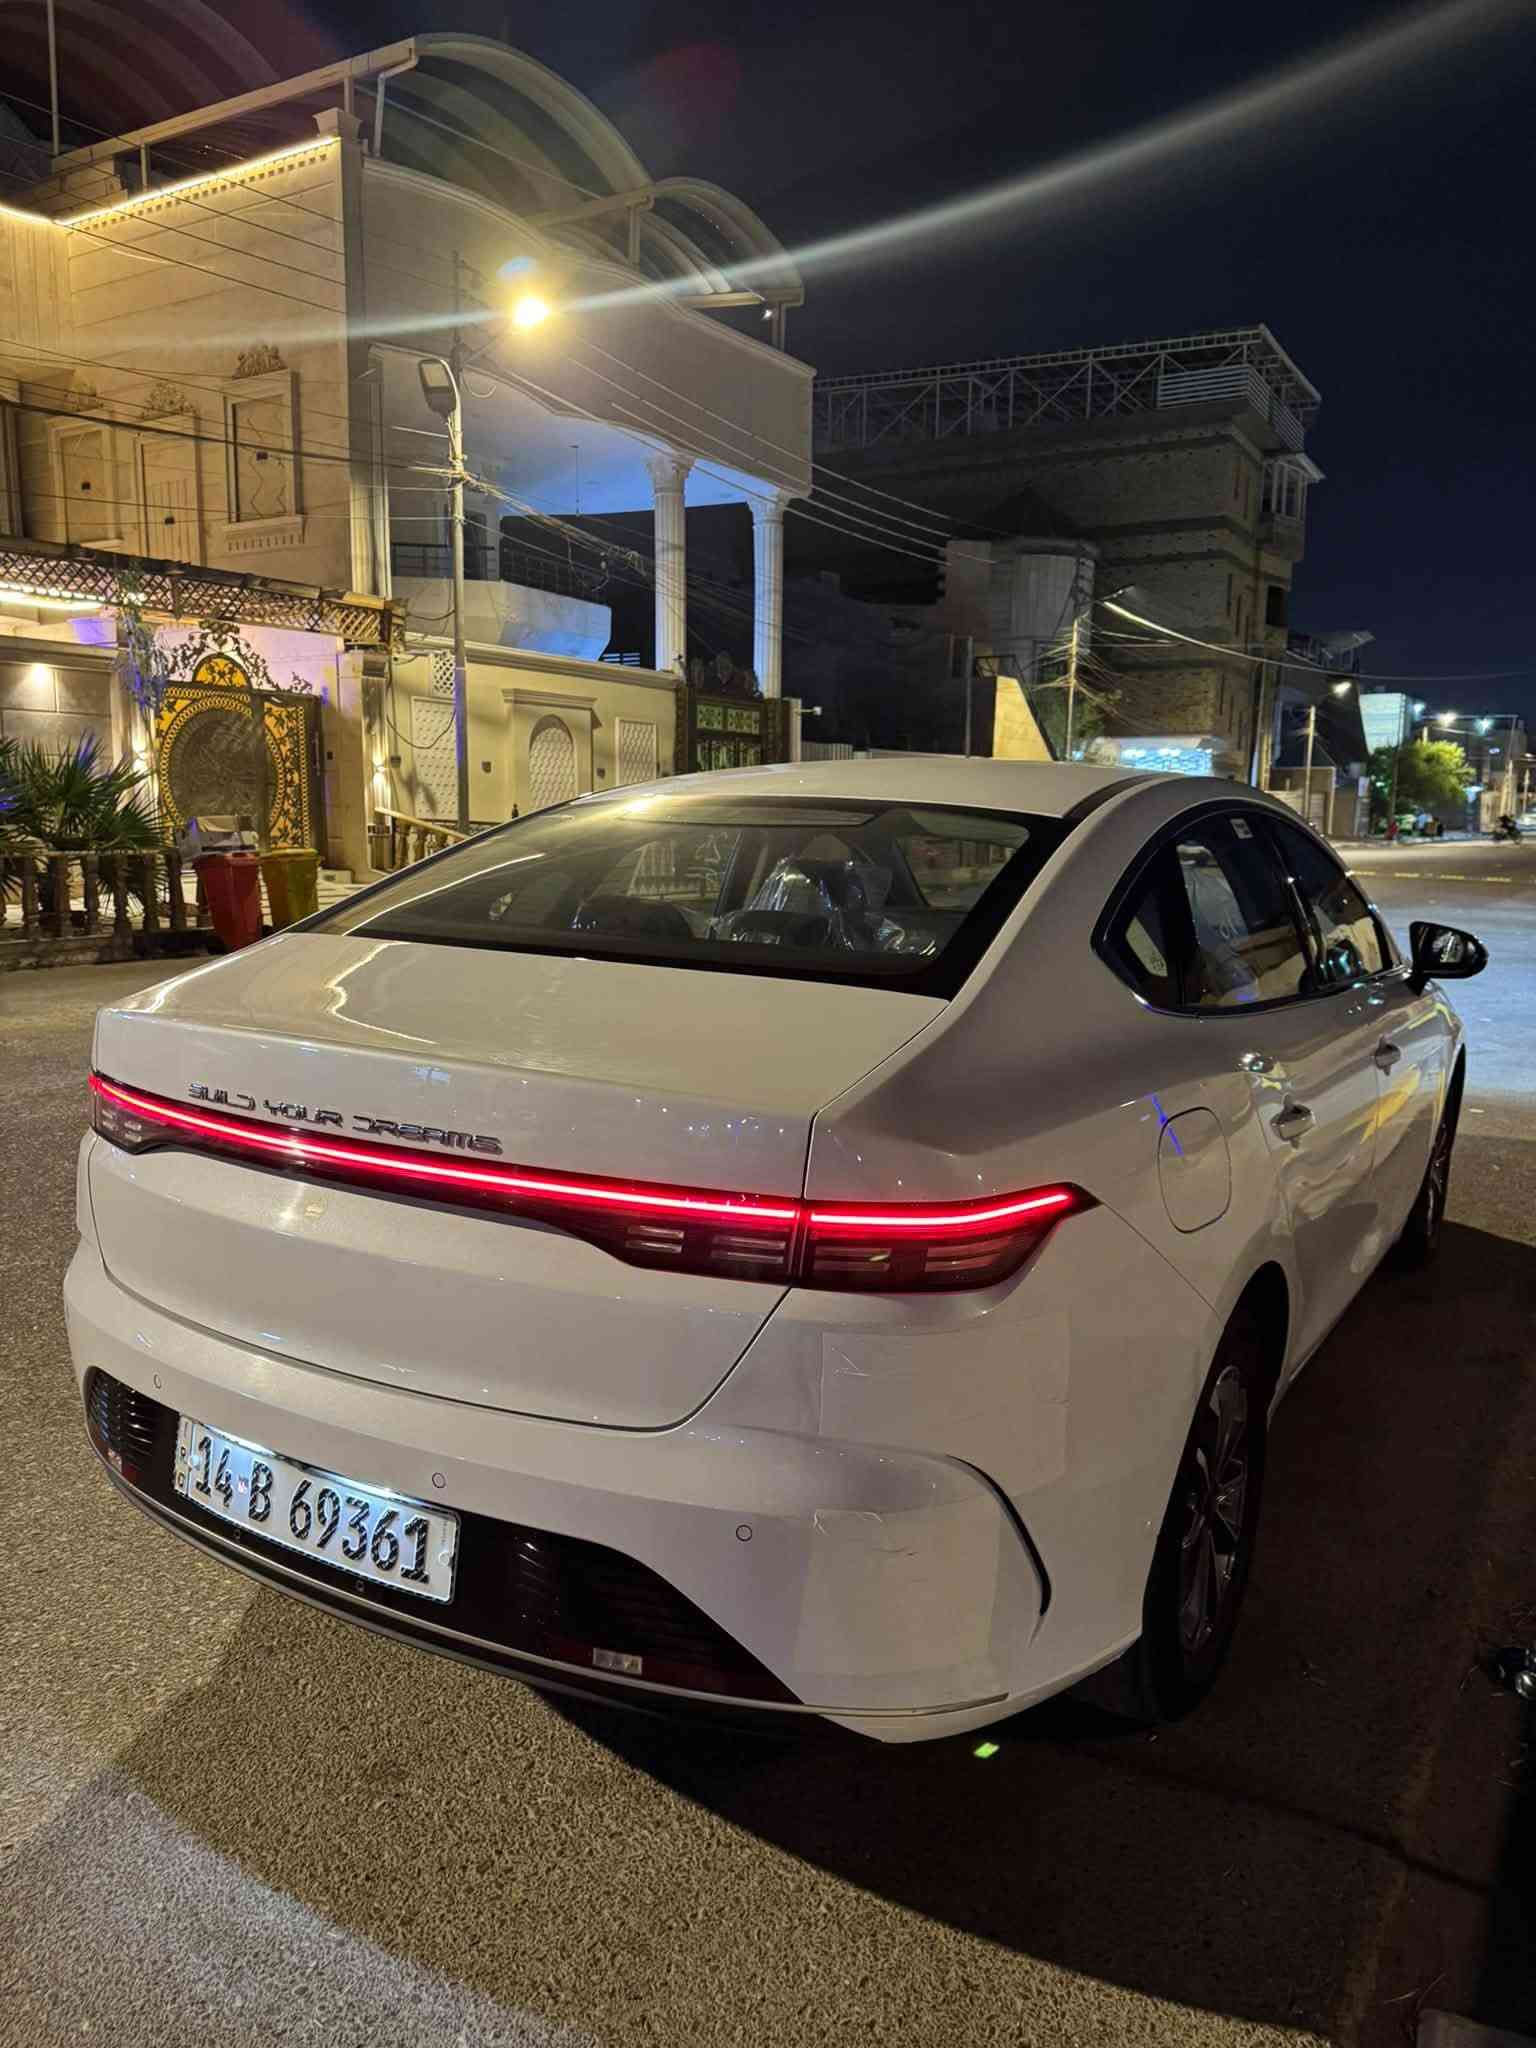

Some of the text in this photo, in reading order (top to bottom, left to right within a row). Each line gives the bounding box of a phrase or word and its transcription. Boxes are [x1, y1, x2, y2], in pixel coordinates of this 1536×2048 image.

[188, 1081, 503, 1155] BUILD YOUR DREAMS
[196, 1436, 430, 1584] 14 B 69361
